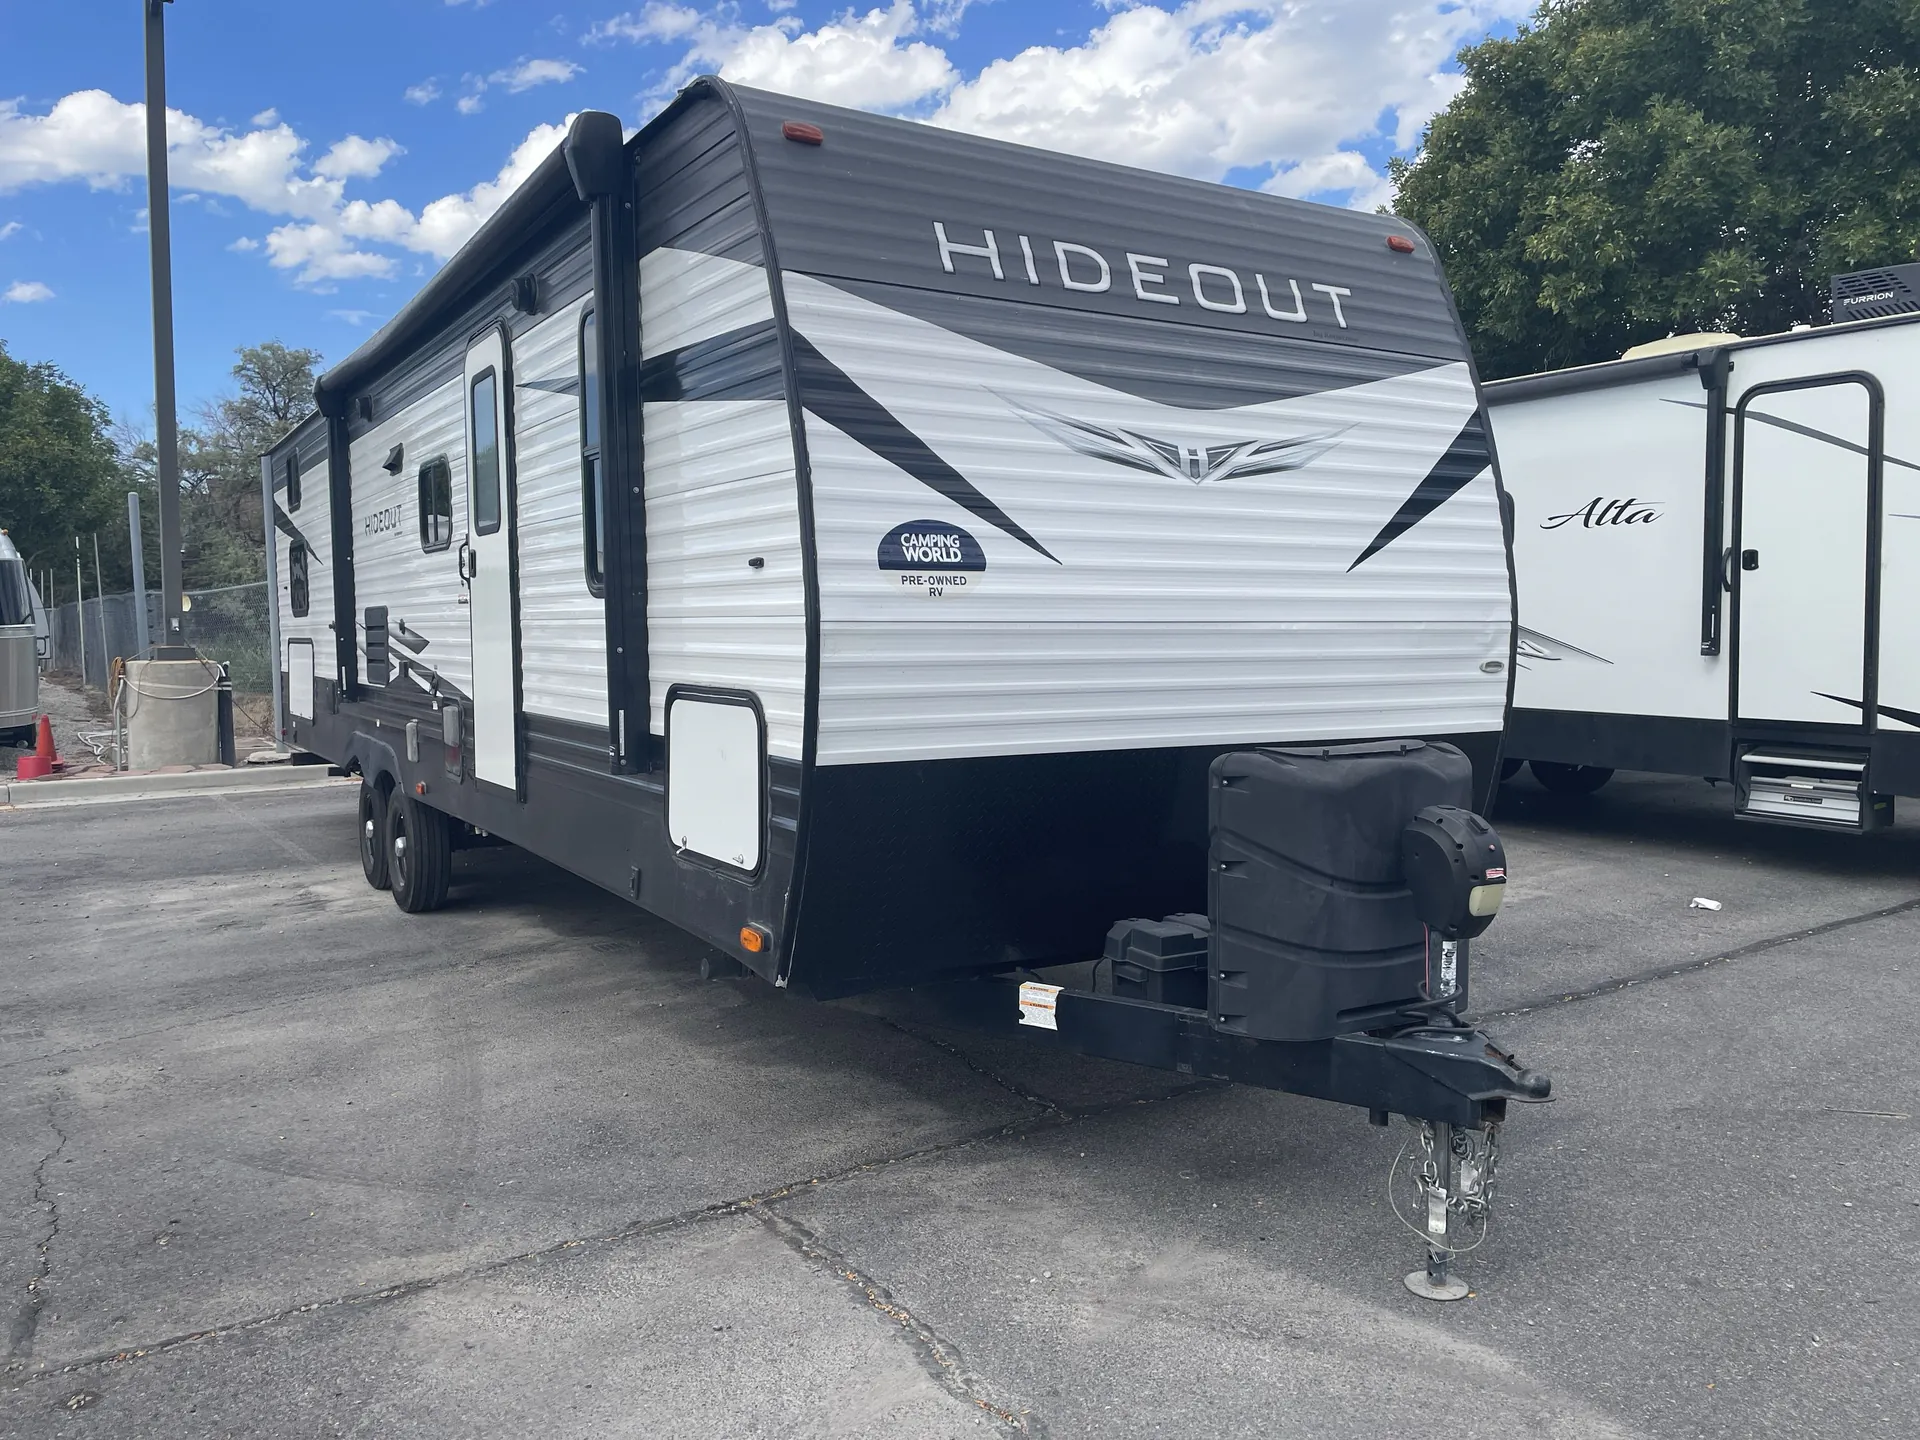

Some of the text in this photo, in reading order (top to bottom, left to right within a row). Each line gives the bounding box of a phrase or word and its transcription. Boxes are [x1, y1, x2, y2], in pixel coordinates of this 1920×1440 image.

[932, 220, 1353, 330] HIDEOUT
[1843, 291, 1895, 306] FURRION
[364, 504, 403, 537] HIDEOUT
[1539, 496, 1667, 530] Alta
[900, 533, 960, 548] CAMPING
[901, 575, 967, 586] PRE-OWNED
[929, 587, 944, 597] RV
